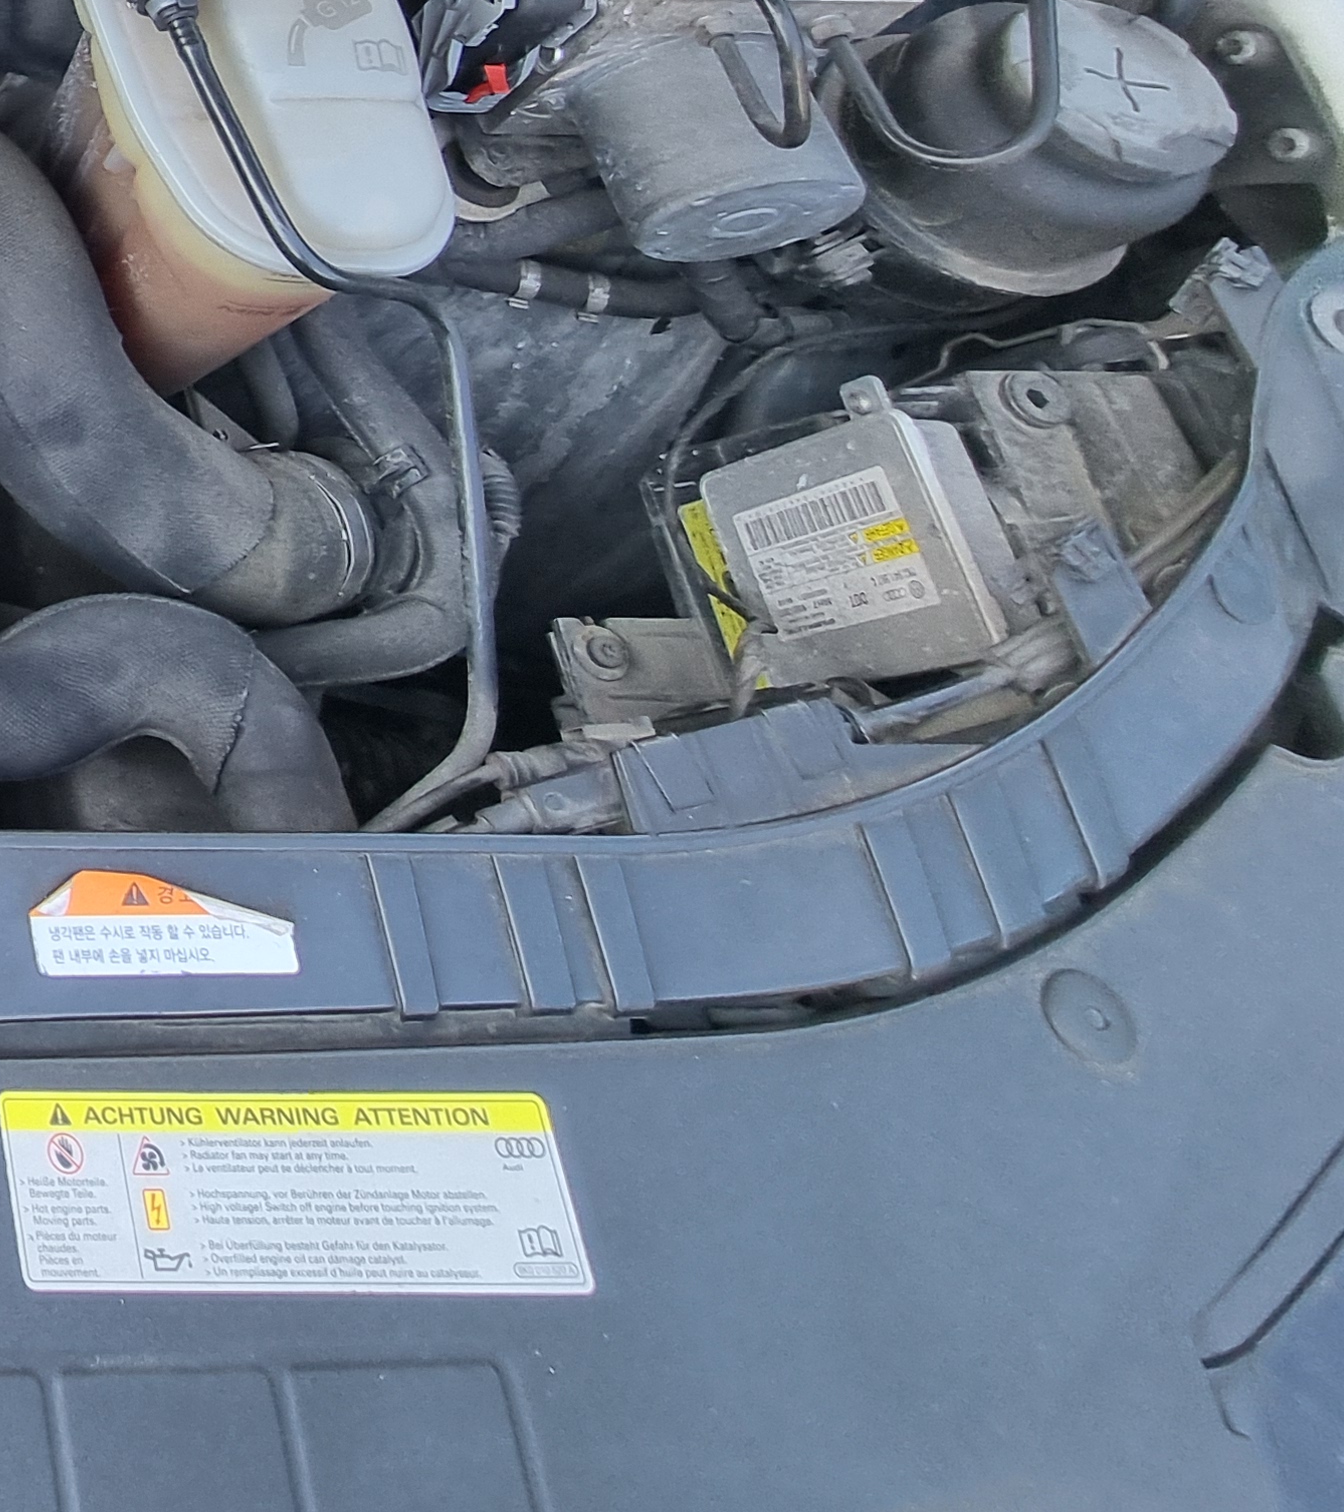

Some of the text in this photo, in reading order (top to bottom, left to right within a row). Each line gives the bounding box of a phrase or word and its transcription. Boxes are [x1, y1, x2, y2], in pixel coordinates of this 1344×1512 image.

[49, 924, 250, 941] 냉각팬은 수시로 작동 할 수 있습니다.
[53, 947, 214, 964] 팬 내부에 손을 넣지 마십시오.
[83, 1106, 490, 1127] ACHTUNG WARNING ATTENTION
